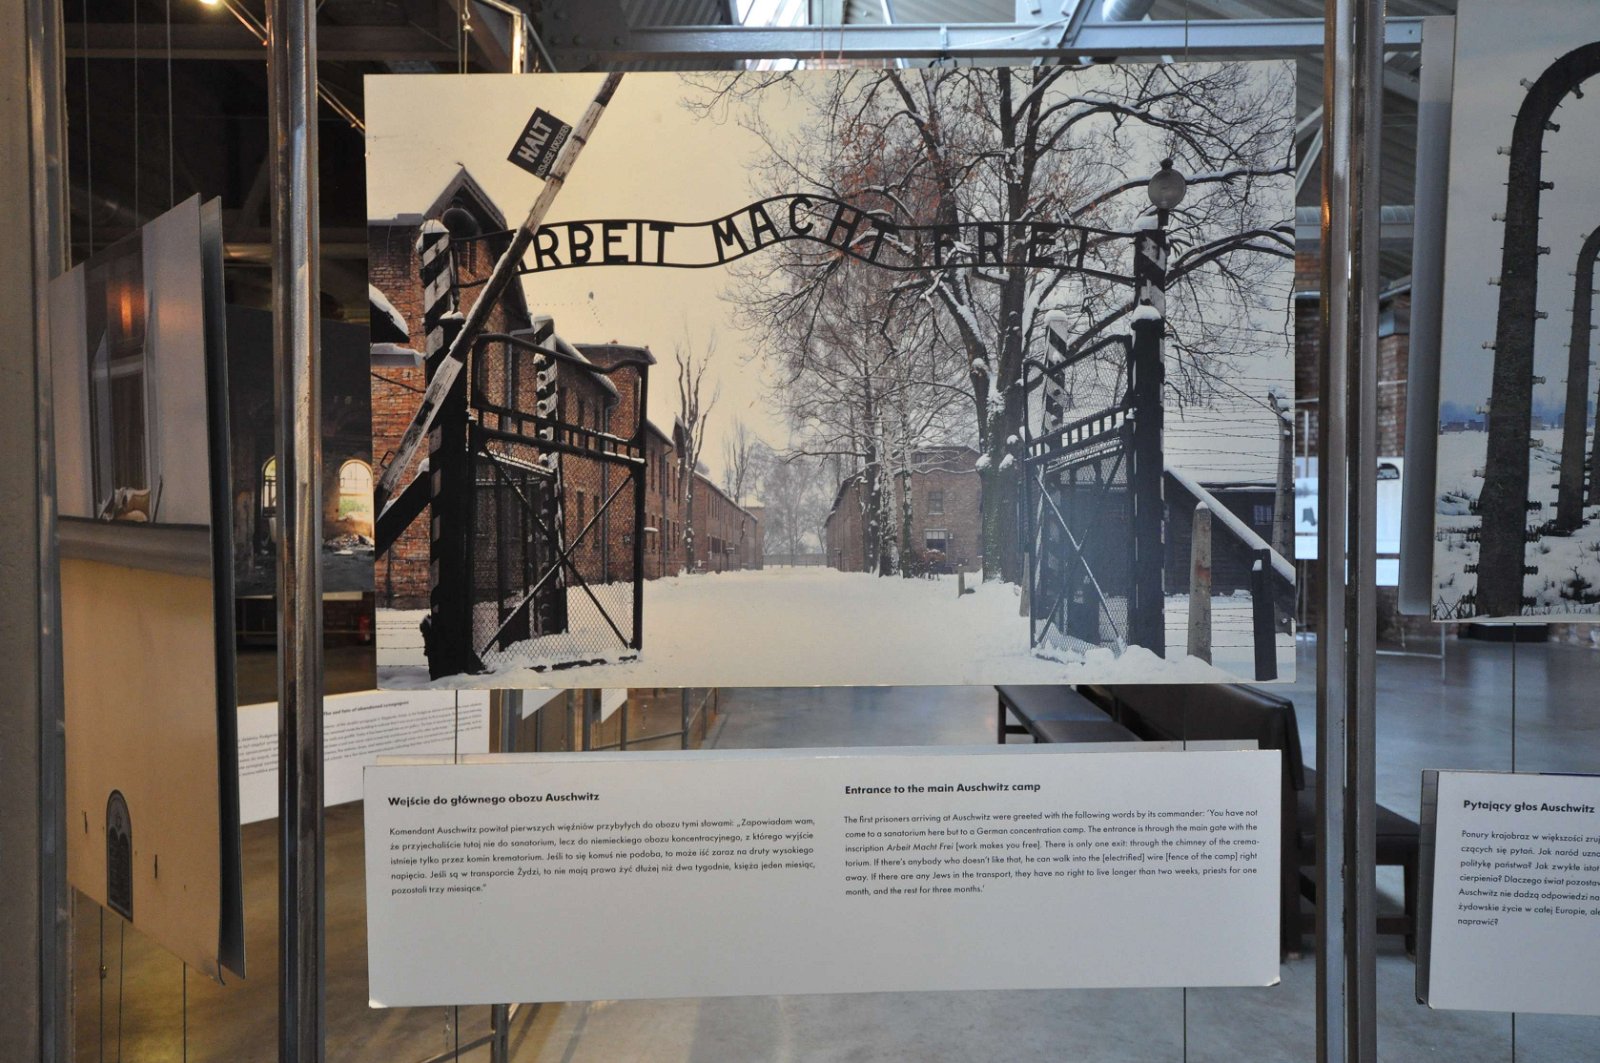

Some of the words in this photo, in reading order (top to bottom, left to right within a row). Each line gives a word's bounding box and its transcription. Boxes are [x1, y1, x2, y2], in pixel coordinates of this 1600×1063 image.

[517, 116, 553, 163] HALT
[711, 197, 899, 263] MACHT
[933, 222, 1090, 269] FREI
[844, 785, 892, 794] Entrance
[893, 785, 906, 794] to
[906, 784, 925, 793] the
[927, 783, 954, 793] main
[955, 782, 1010, 792] Auschwitz
[1011, 783, 1041, 793] camp
[387, 796, 431, 808] Wejście
[432, 795, 448, 805] do
[449, 794, 506, 807] głównego
[507, 793, 543, 803] obozu
[544, 792, 600, 802] Auschwitz
[1462, 799, 1512, 812] Pytający
[1513, 801, 1538, 813] głos
[1539, 802, 1595, 813] Auschwitz
[843, 815, 858, 823] The
[858, 815, 874, 823] first
[874, 815, 910, 825] prisoners
[910, 814, 941, 824] arriving
[951, 813, 991, 821] Auschwitz
[1012, 811, 1043, 822] greeted
[1043, 811, 1060, 819] with
[1060, 811, 1074, 819] the
[1073, 810, 1111, 821] following
[1111, 809, 1135, 818] words
[1135, 810, 1147, 819] by
[1147, 810, 1156, 818] its
[1156, 809, 1205, 818] commander:
[1224, 808, 1245, 817] have
[389, 826, 435, 835] Komendant
[436, 825, 477, 834] Auschwitz
[510, 823, 555, 834] pierwszych
[641, 820, 654, 829] do
[654, 820, 681, 828] obozu
[681, 820, 699, 829] tymi
[926, 828, 945, 836] here
[946, 827, 959, 836] but
[959, 828, 968, 836] to
[975, 826, 1008, 835] German
[1008, 826, 1062, 835] concentration
[1061, 827, 1086, 835] camp.
[1087, 825, 1102, 833] The
[1137, 824, 1144, 832] is
[1144, 823, 1175, 834] through
[1174, 824, 1188, 832] the
[1208, 824, 1227, 833] gate
[1227, 823, 1244, 831] with
[1244, 822, 1258, 831] the
[462, 840, 481, 849] tutaj
[496, 839, 509, 847] do
[510, 839, 557, 847] sanatorium,
[558, 837, 576, 845] lecz
[577, 837, 589, 845] do
[590, 835, 643, 846] niemieckiego
[643, 835, 670, 843] obozu
[671, 833, 743, 843] koncentracyjnego,
[1460, 829, 1490, 840] Ponury
[1490, 830, 1530, 841] krajobraz
[390, 856, 418, 866] istnieje
[418, 855, 440, 865] tylko
[440, 857, 465, 865] przez
[466, 854, 490, 863] komin
[492, 853, 544, 862] krematorium.
[614, 851, 628, 859] nie
[628, 849, 663, 860] podoba,
[748, 847, 770, 856] druty
[771, 845, 814, 856] wysokiego
[1536, 847, 1552, 855] Jak
[1534, 861, 1549, 870] Jak
[1458, 873, 1503, 883] cierpienia?
[1503, 874, 1542, 886] Dlaczego
[391, 885, 428, 896] pozostali
[428, 886, 445, 894] trzy
[845, 887, 872, 896] month,
[872, 886, 889, 895] and
[889, 886, 902, 894] the
[919, 885, 931, 894] for
[931, 885, 952, 893] three
[1457, 887, 1498, 897] Auschwitz
[1540, 891, 1588, 901] odpowiedzi
[1554, 905, 1588, 916] Europie,
